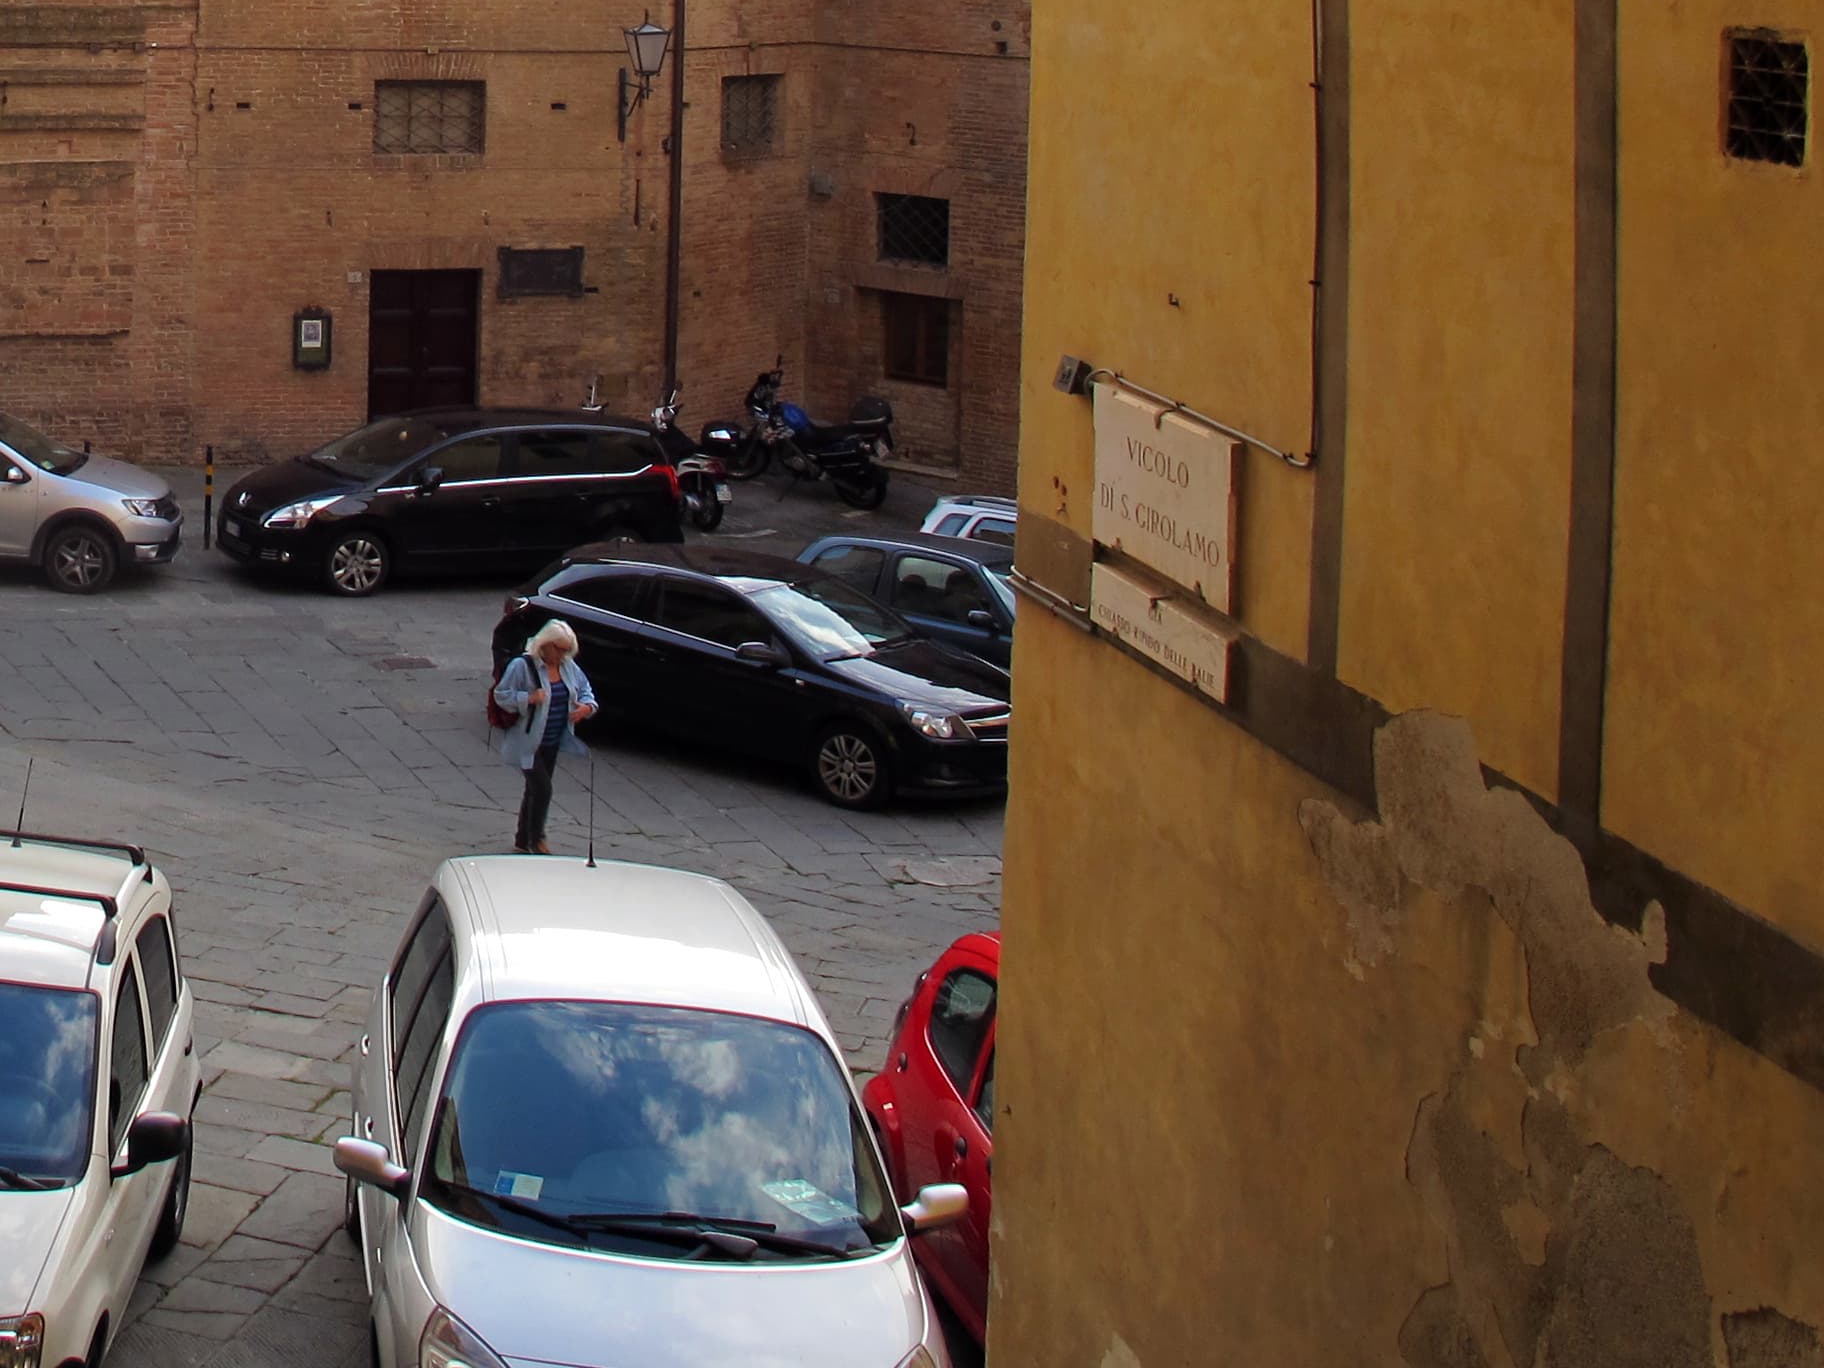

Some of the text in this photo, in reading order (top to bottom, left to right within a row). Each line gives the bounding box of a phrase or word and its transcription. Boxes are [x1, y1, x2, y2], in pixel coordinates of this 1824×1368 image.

[1127, 435, 1189, 489] VICOLO
[1100, 482, 1219, 568] DI S. GIROLAMO
[1163, 644, 1188, 673] DELLE
